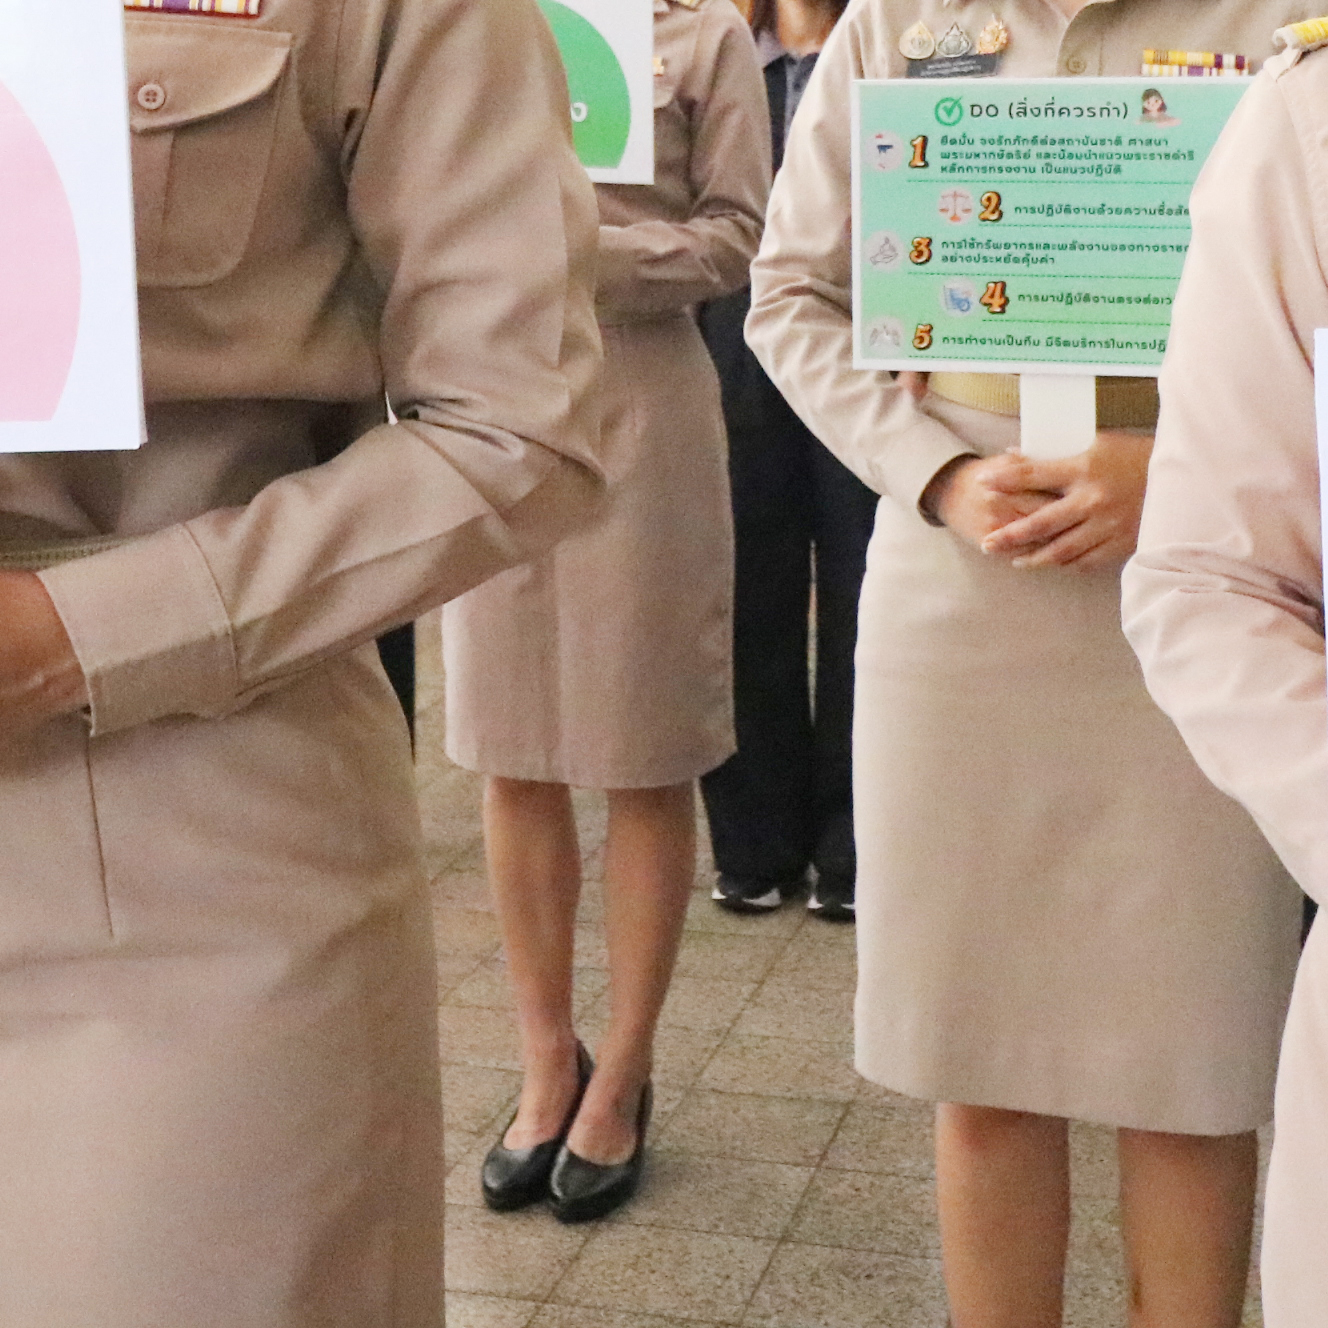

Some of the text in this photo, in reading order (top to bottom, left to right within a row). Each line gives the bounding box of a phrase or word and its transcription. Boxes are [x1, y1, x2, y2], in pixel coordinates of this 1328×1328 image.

[969, 103, 1000, 118] DO
[908, 134, 930, 169] 1
[978, 190, 1004, 222] 2
[908, 236, 933, 265] 3
[979, 280, 1010, 314] 4
[912, 322, 934, 351] 5
